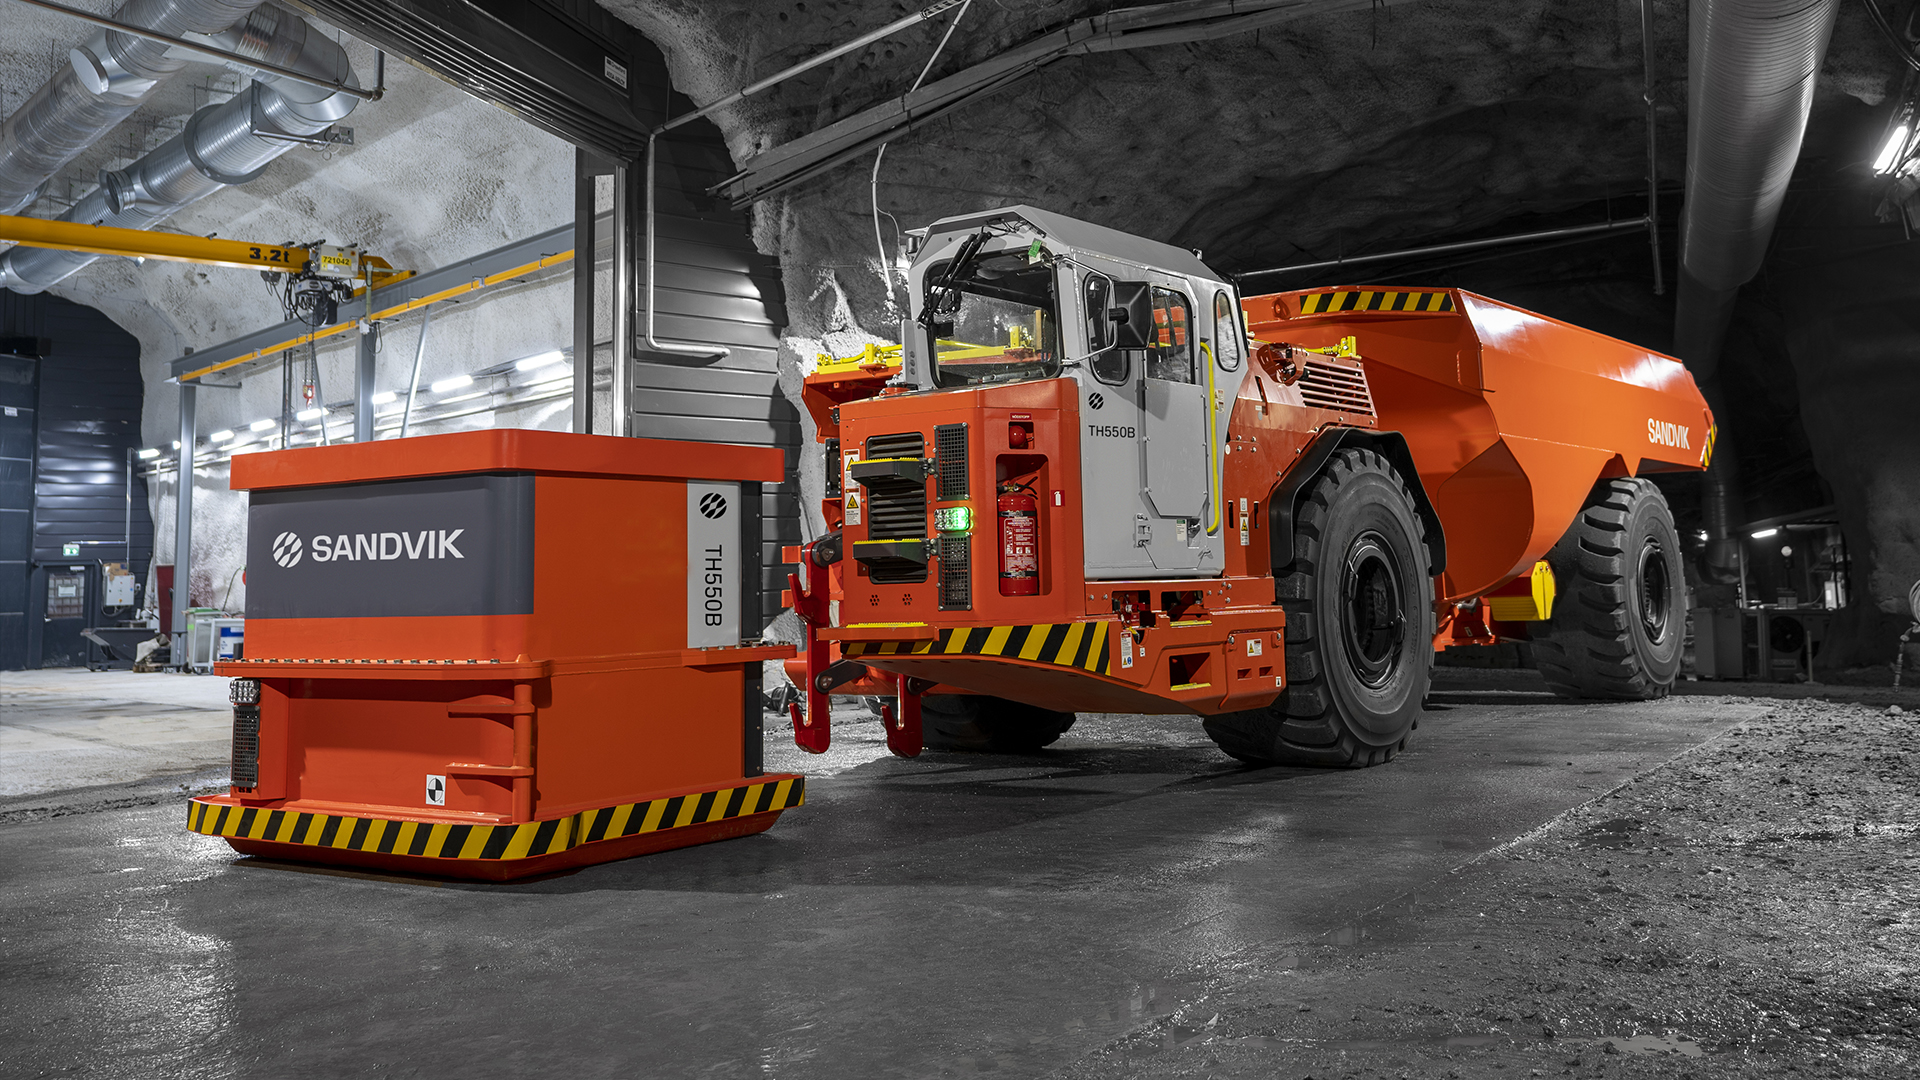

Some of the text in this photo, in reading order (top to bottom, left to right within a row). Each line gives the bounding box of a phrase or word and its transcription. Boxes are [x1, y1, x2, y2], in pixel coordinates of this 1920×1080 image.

[323, 256, 350, 266] 721042
[1088, 425, 1136, 438] TH550B
[1648, 418, 1690, 450] SANDVIK
[311, 529, 465, 562] SANDVIK
[705, 544, 723, 627] TH550B
